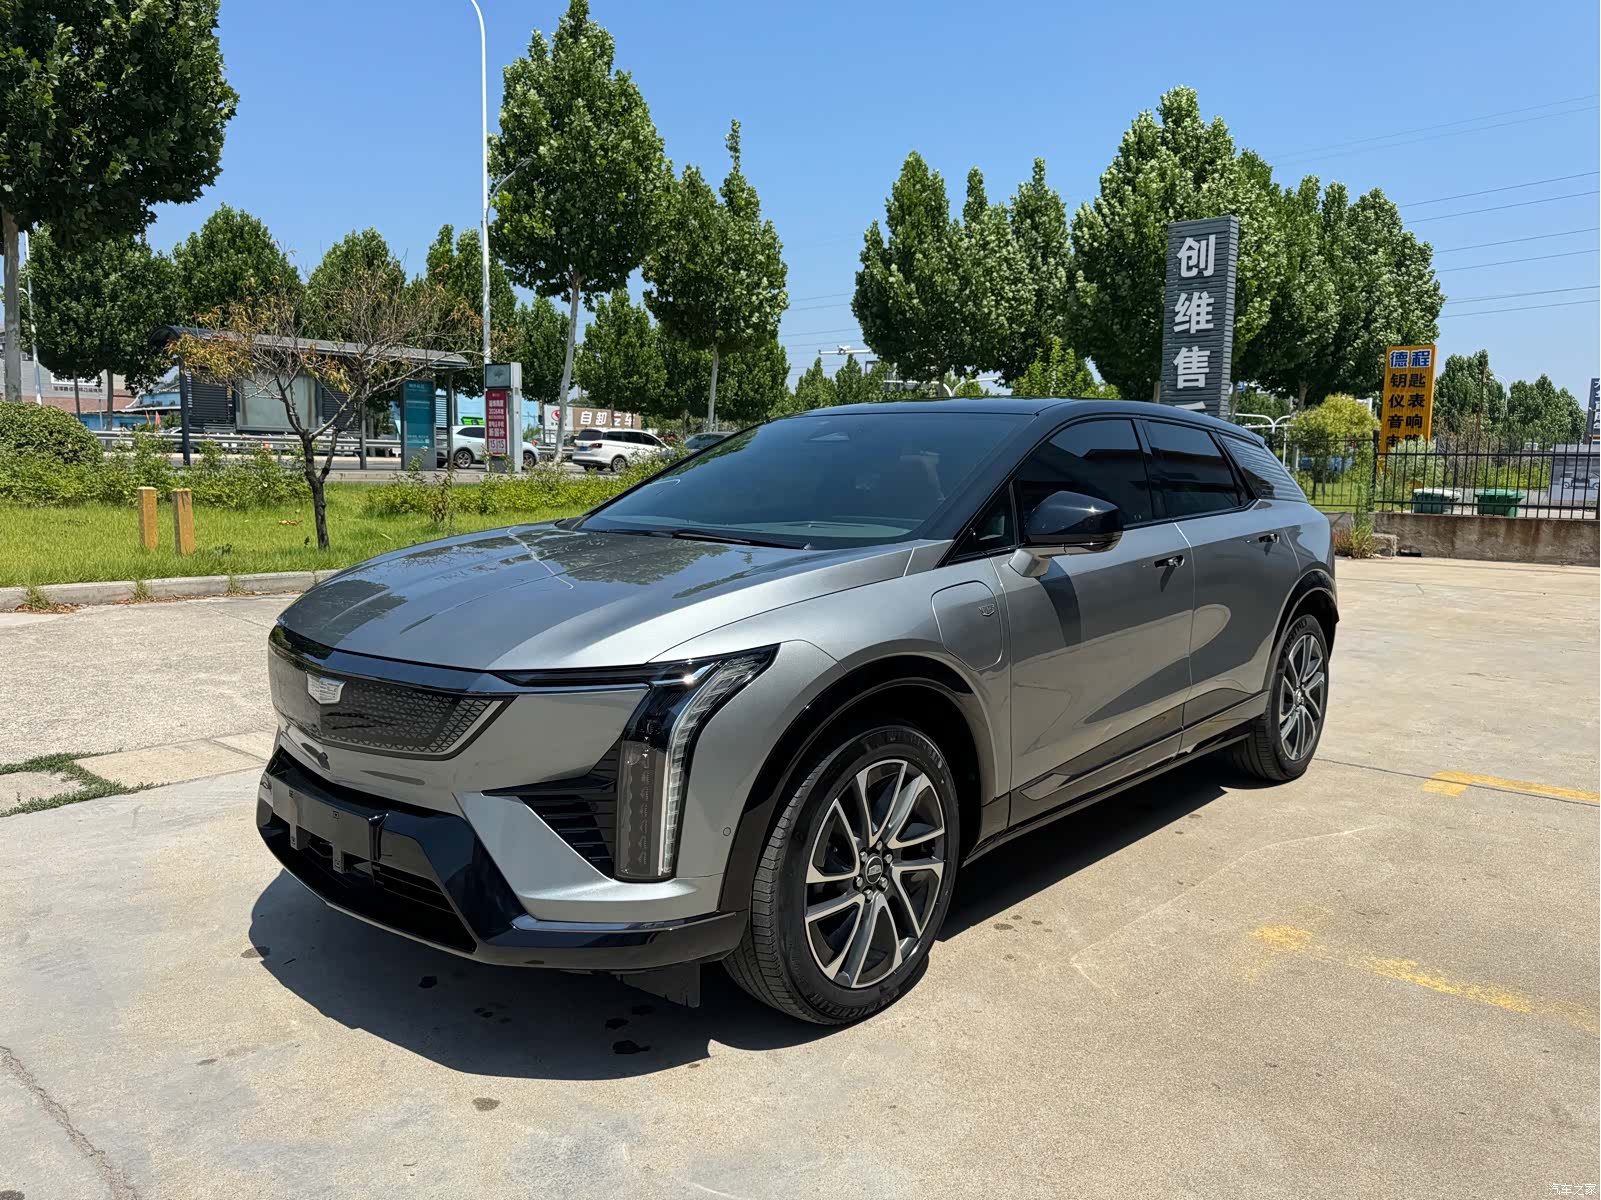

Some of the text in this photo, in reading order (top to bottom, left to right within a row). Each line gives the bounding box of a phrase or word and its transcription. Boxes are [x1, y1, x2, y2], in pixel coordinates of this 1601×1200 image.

[1172, 234, 1216, 415] 创维售
[1390, 349, 1432, 368] 德程
[1390, 373, 1426, 389] 钥匙
[1388, 393, 1425, 408] 仪表
[1387, 414, 1423, 429] 音响
